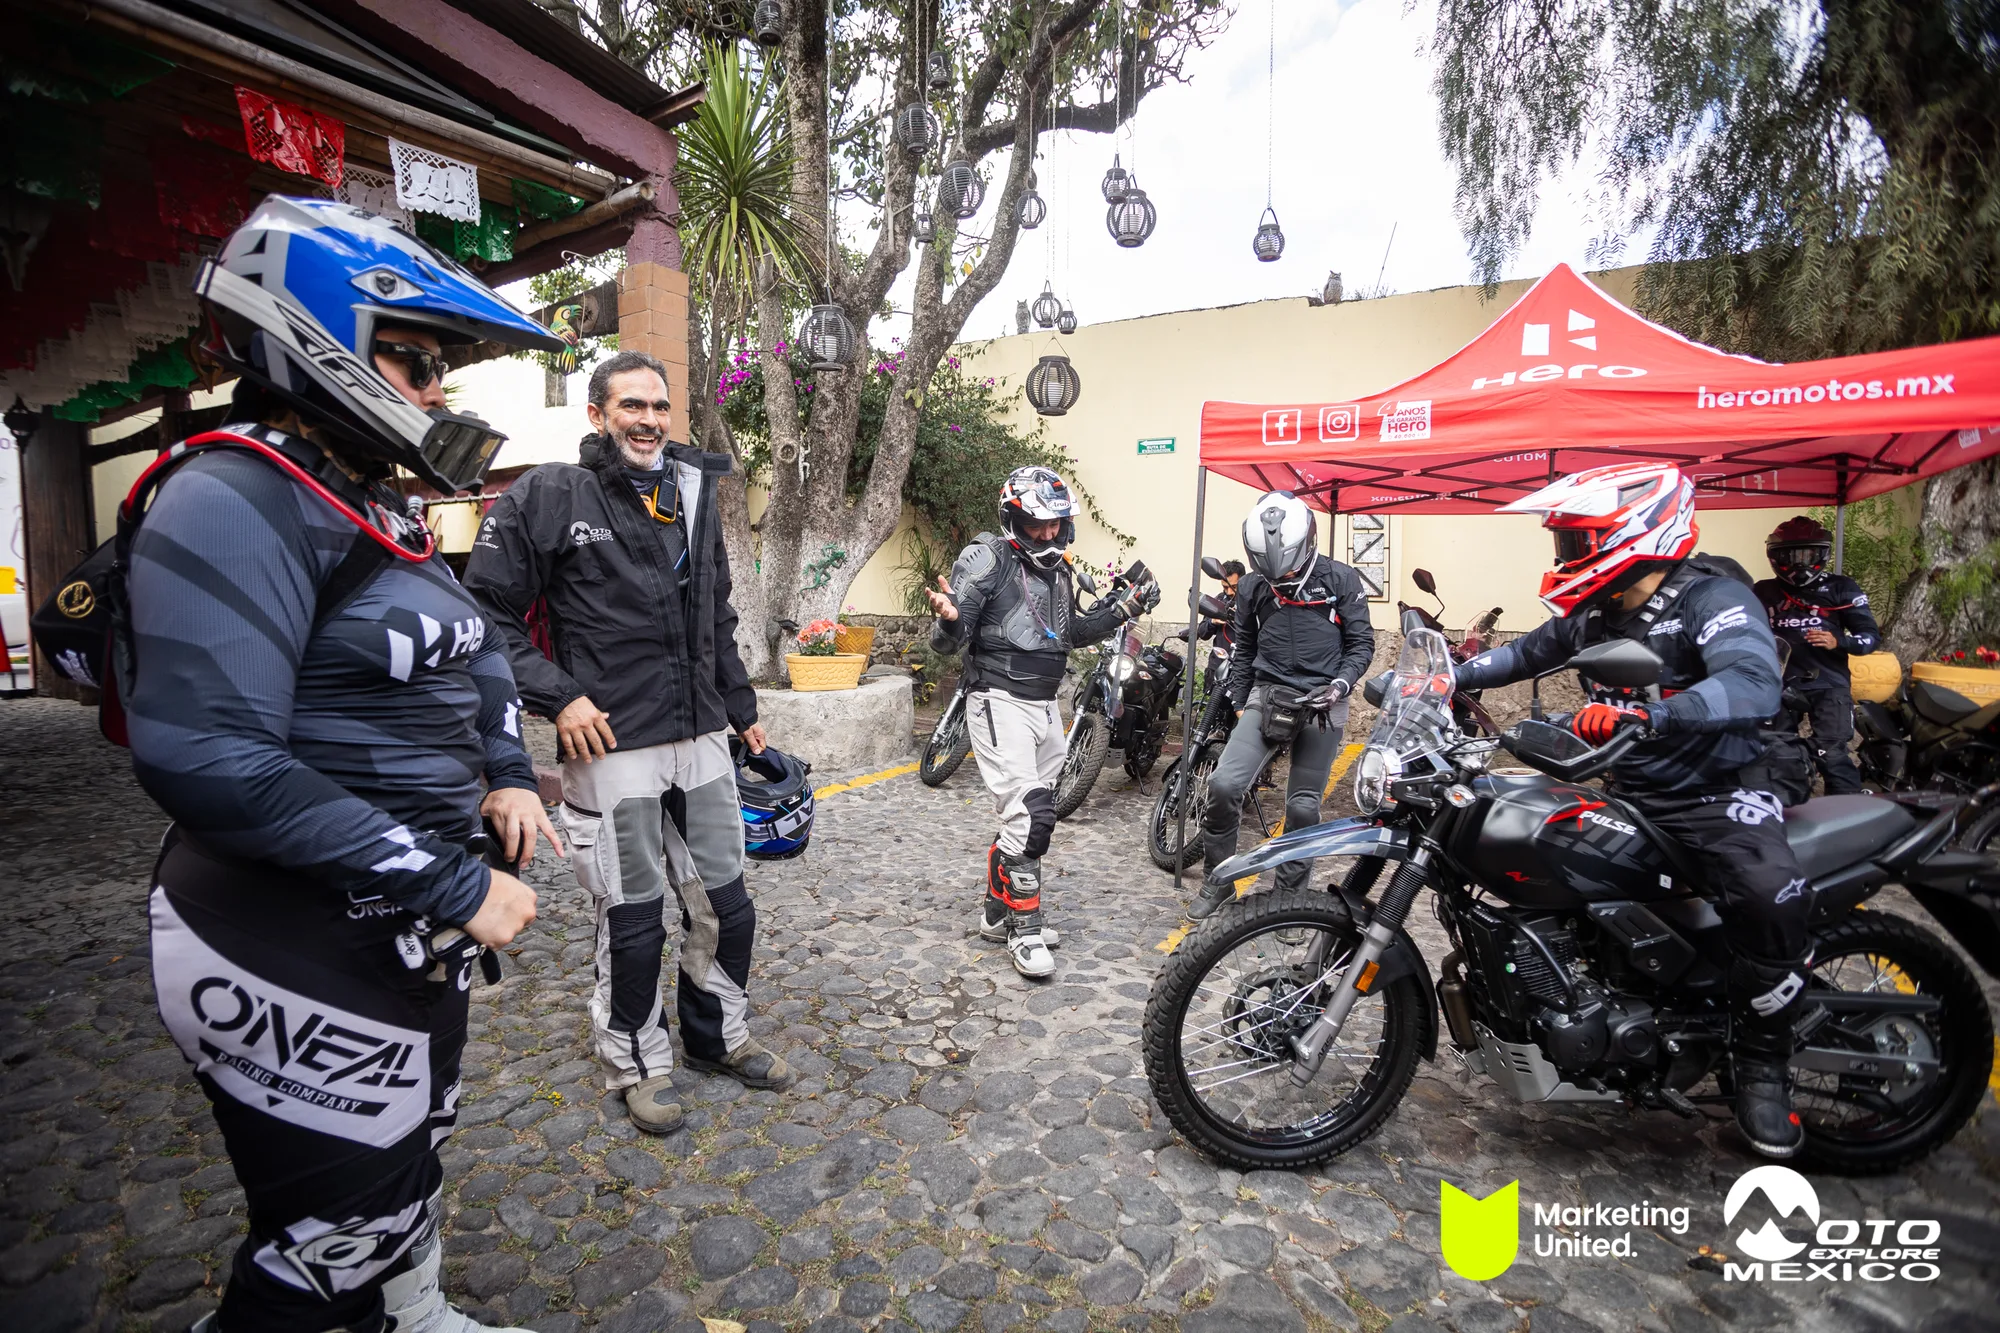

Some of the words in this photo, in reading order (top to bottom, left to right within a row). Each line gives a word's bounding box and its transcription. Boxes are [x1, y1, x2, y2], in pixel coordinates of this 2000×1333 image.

[1471, 364, 1648, 390] Hero
[1697, 374, 1955, 408] heromotos.mx
[1397, 406, 1426, 416] AÑOS
[1388, 420, 1426, 433] Hero
[1778, 617, 1822, 627] Hero
[215, 1051, 274, 1086] RACING
[277, 1077, 363, 1113] COMPANY
